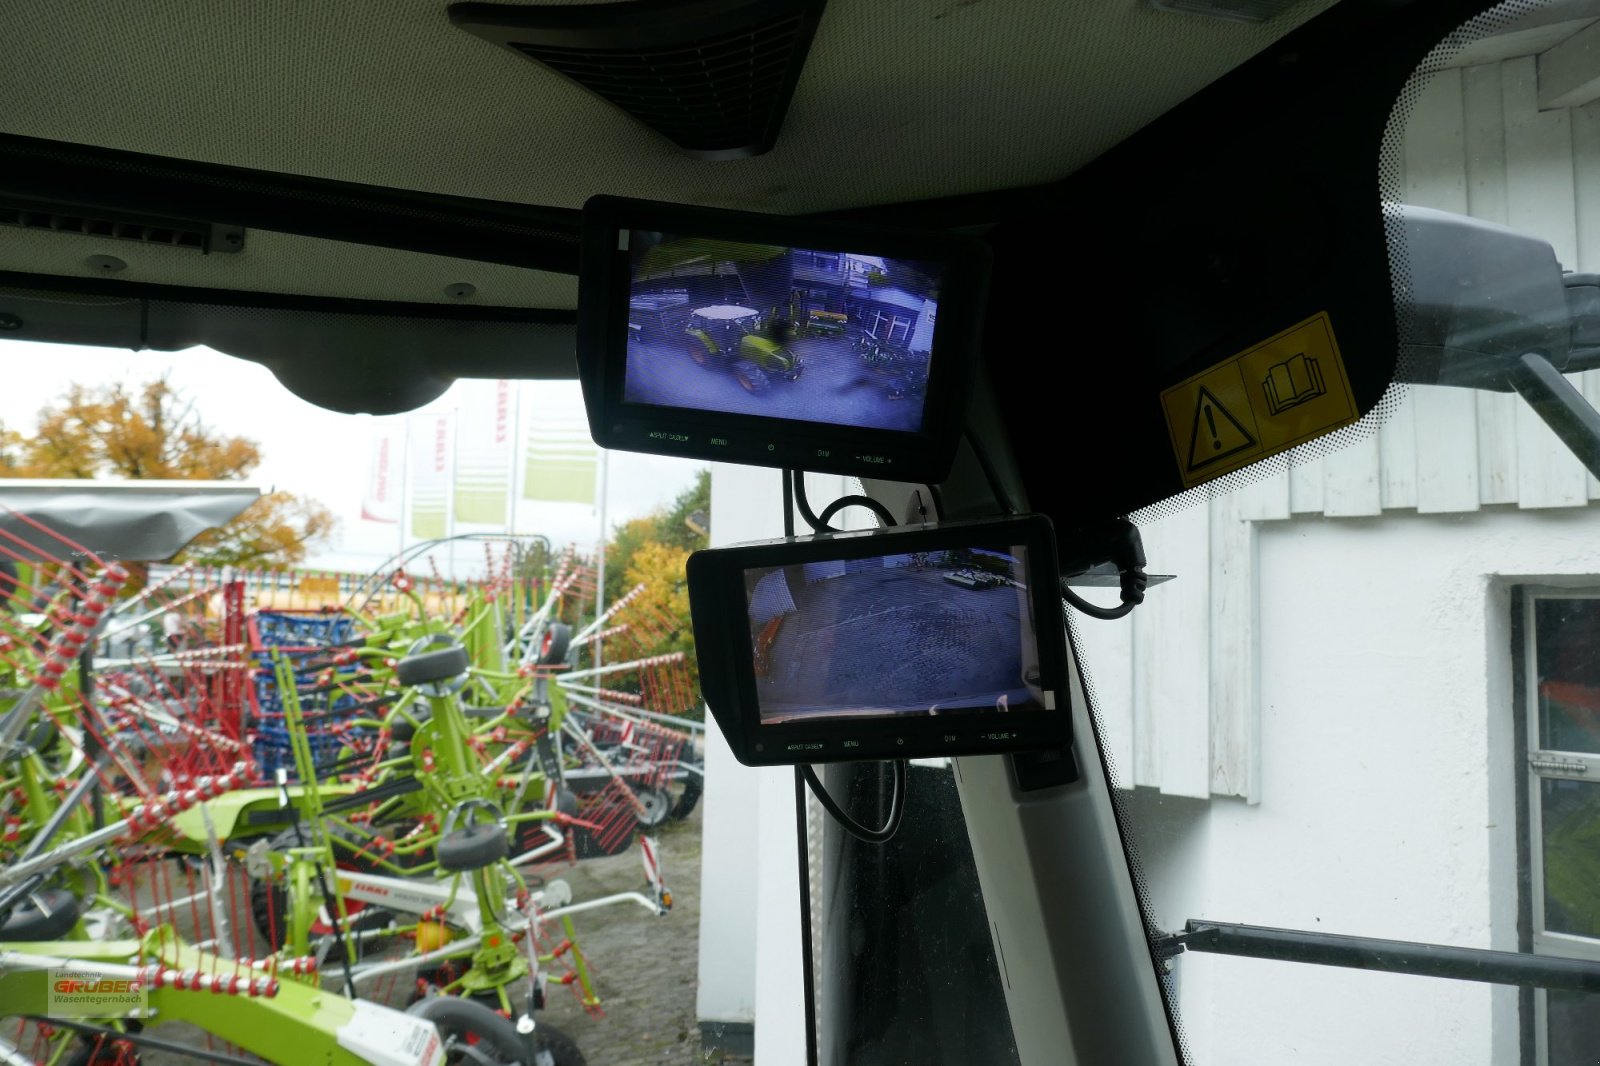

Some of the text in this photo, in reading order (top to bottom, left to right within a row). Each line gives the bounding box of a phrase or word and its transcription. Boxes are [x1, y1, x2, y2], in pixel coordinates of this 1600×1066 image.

[711, 438, 728, 446] MENU
[817, 449, 830, 457] DIM
[862, 456, 885, 464] VOLUME
[987, 732, 1010, 740] VOLUME
[843, 740, 859, 748] MENU
